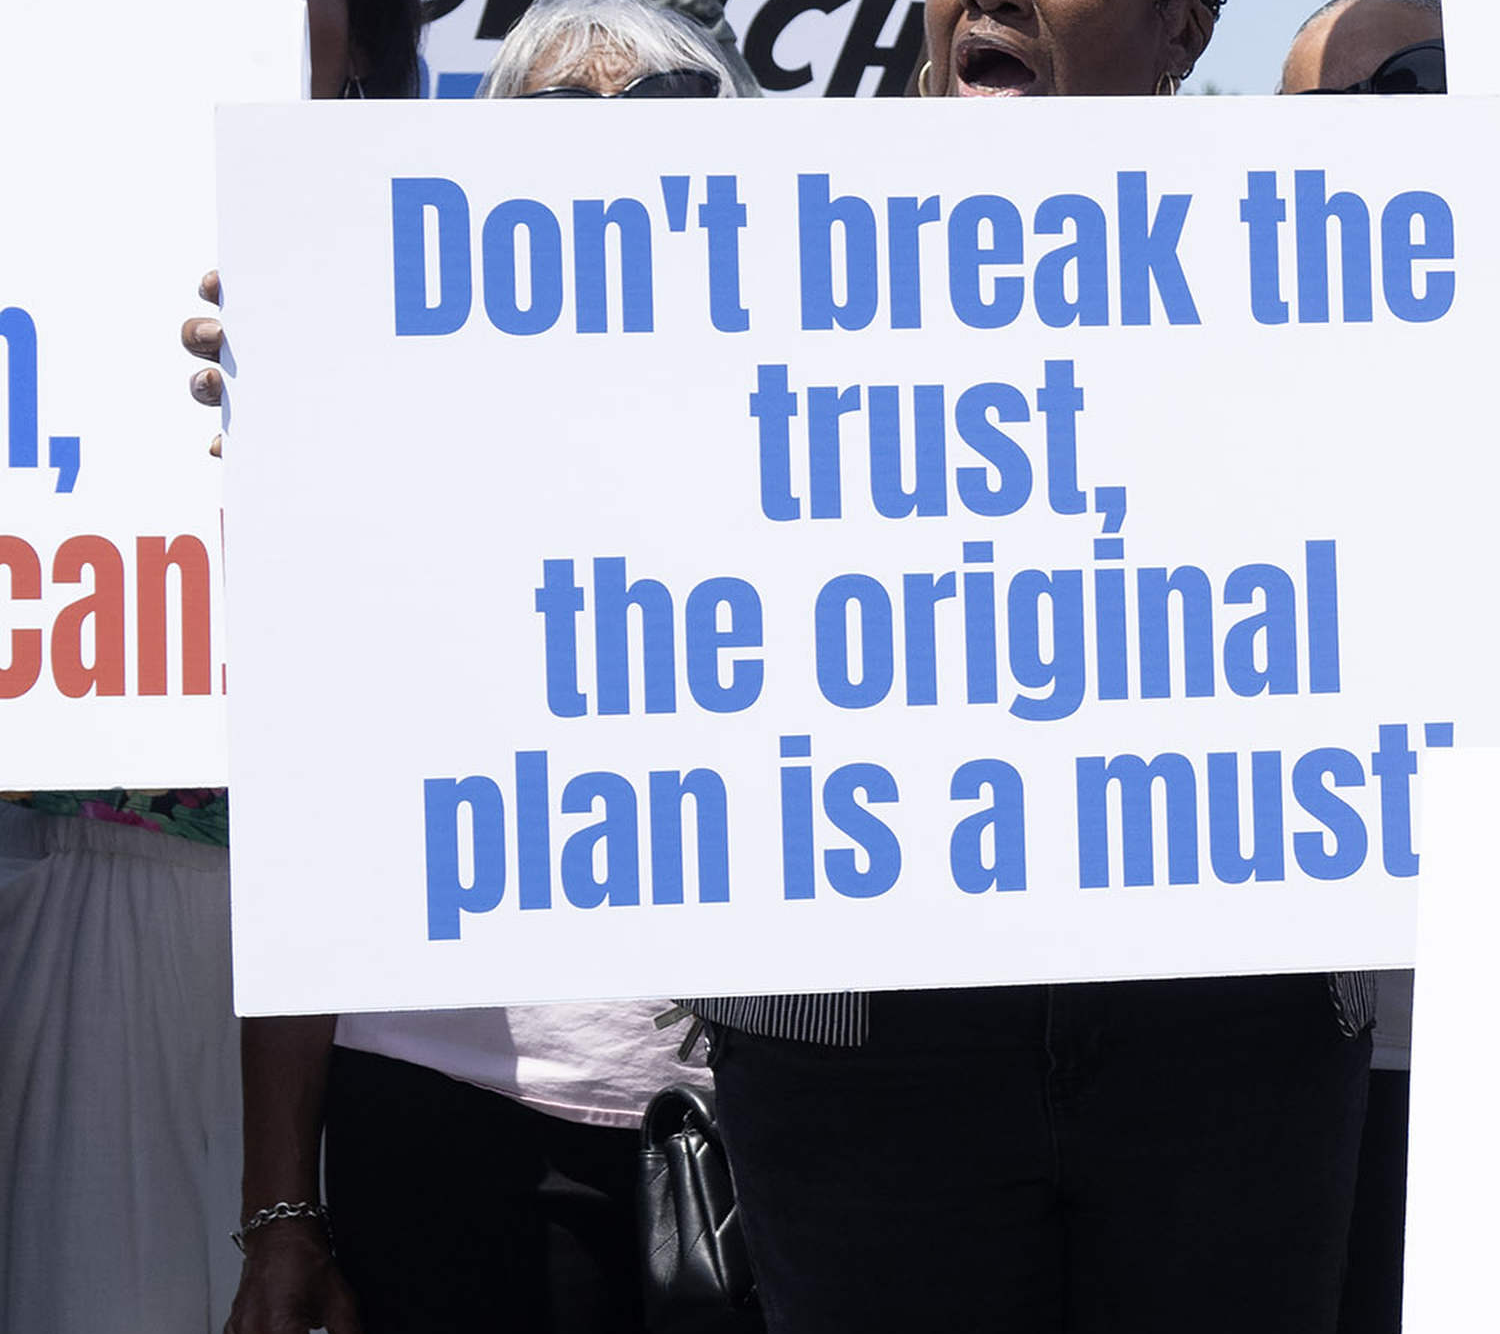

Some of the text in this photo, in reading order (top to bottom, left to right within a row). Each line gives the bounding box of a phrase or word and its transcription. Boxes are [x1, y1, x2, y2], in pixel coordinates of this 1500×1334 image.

[392, 169, 1455, 336] Don't break the
[749, 360, 1126, 534] trust,
[0, 534, 227, 700] can
[535, 538, 1341, 721] the original
[423, 722, 1456, 942] plan is a must
